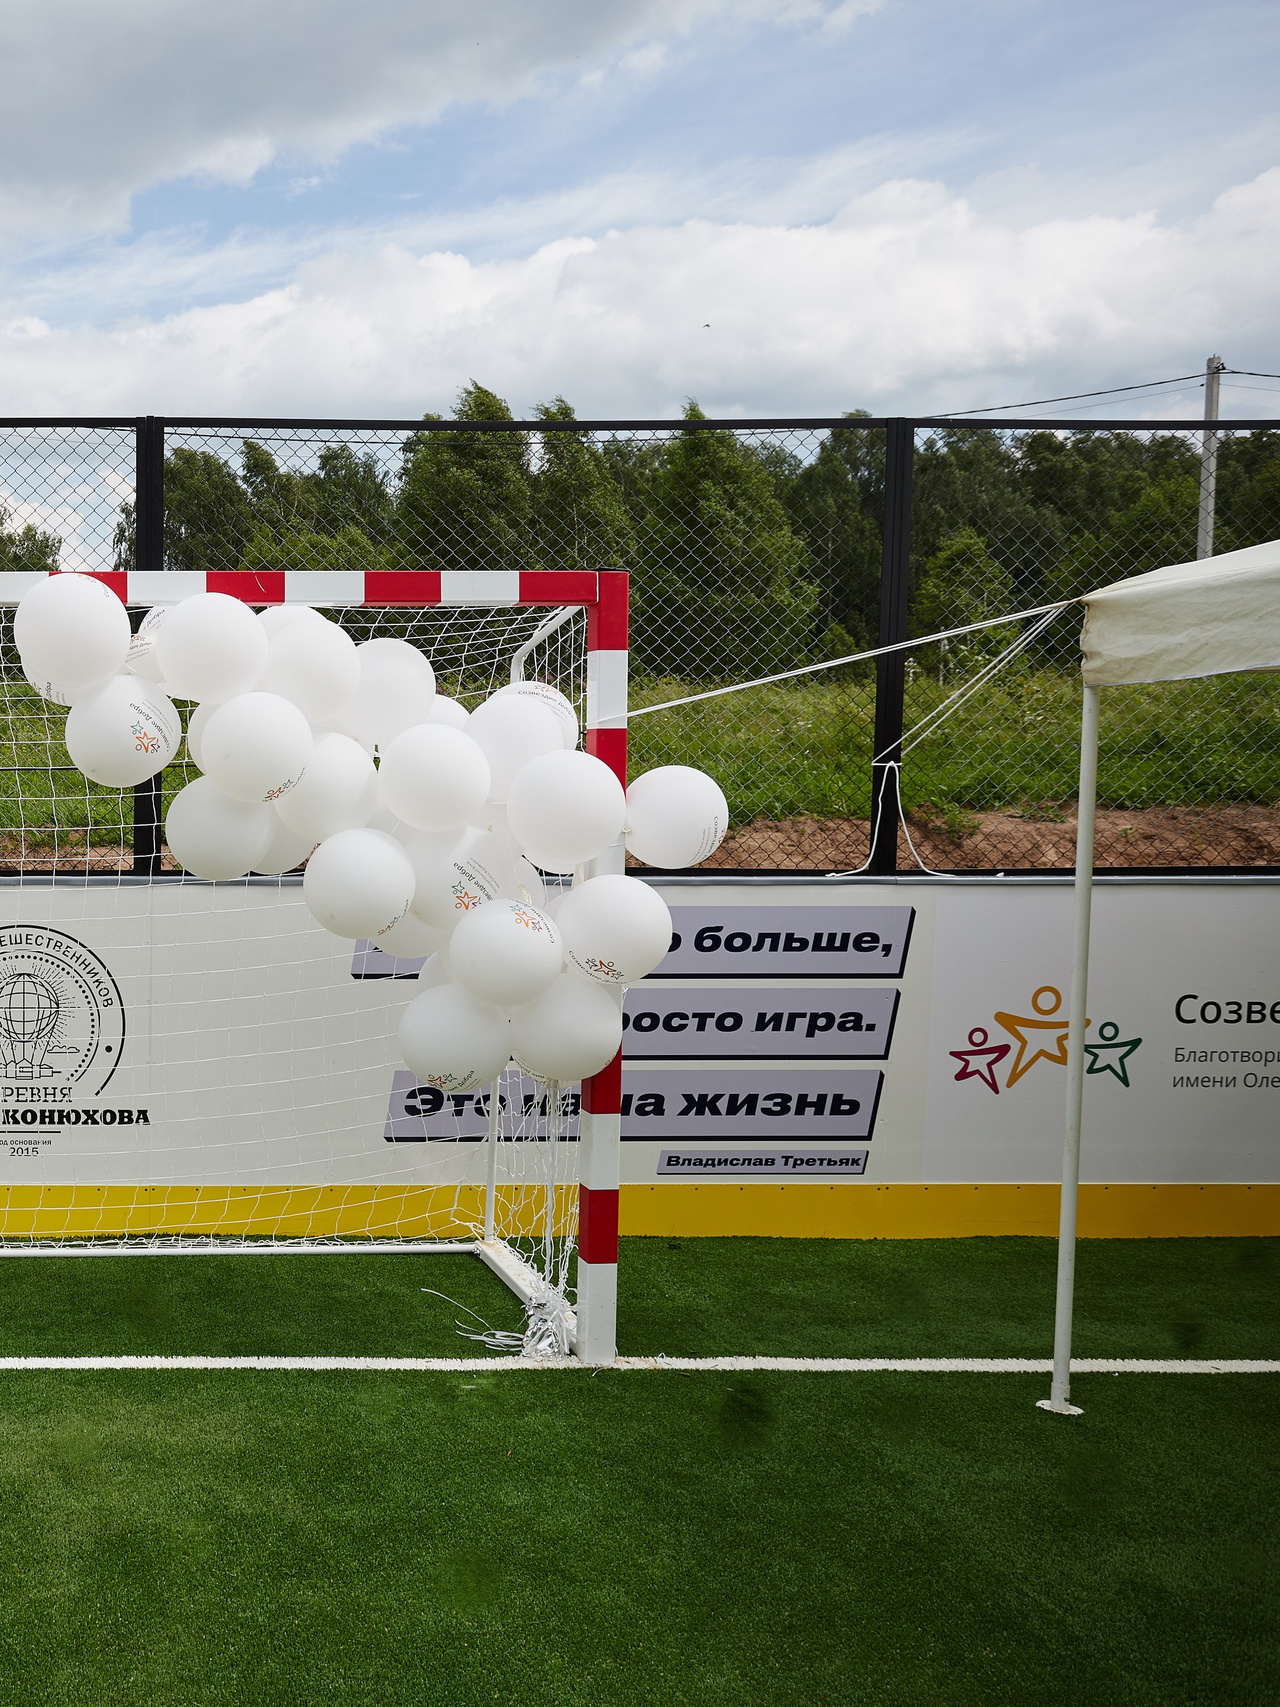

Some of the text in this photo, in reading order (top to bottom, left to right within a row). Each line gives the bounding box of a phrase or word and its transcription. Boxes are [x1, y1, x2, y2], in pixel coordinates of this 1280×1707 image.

[129, 702, 152, 722] Добра
[453, 862, 476, 882] Добра
[693, 925, 893, 958] больше,
[1175, 993, 1280, 1024] Созве
[622, 1011, 877, 1038] осто игра.
[1174, 1047, 1280, 1068] Благотвор
[1172, 1072, 1280, 1088] имени Оле
[677, 1093, 861, 1117] жизнь
[2, 1108, 150, 1126] КОНЮХОВА
[9, 1147, 39, 1157] 2015
[667, 1156, 862, 1168] Владислав Третьяк
